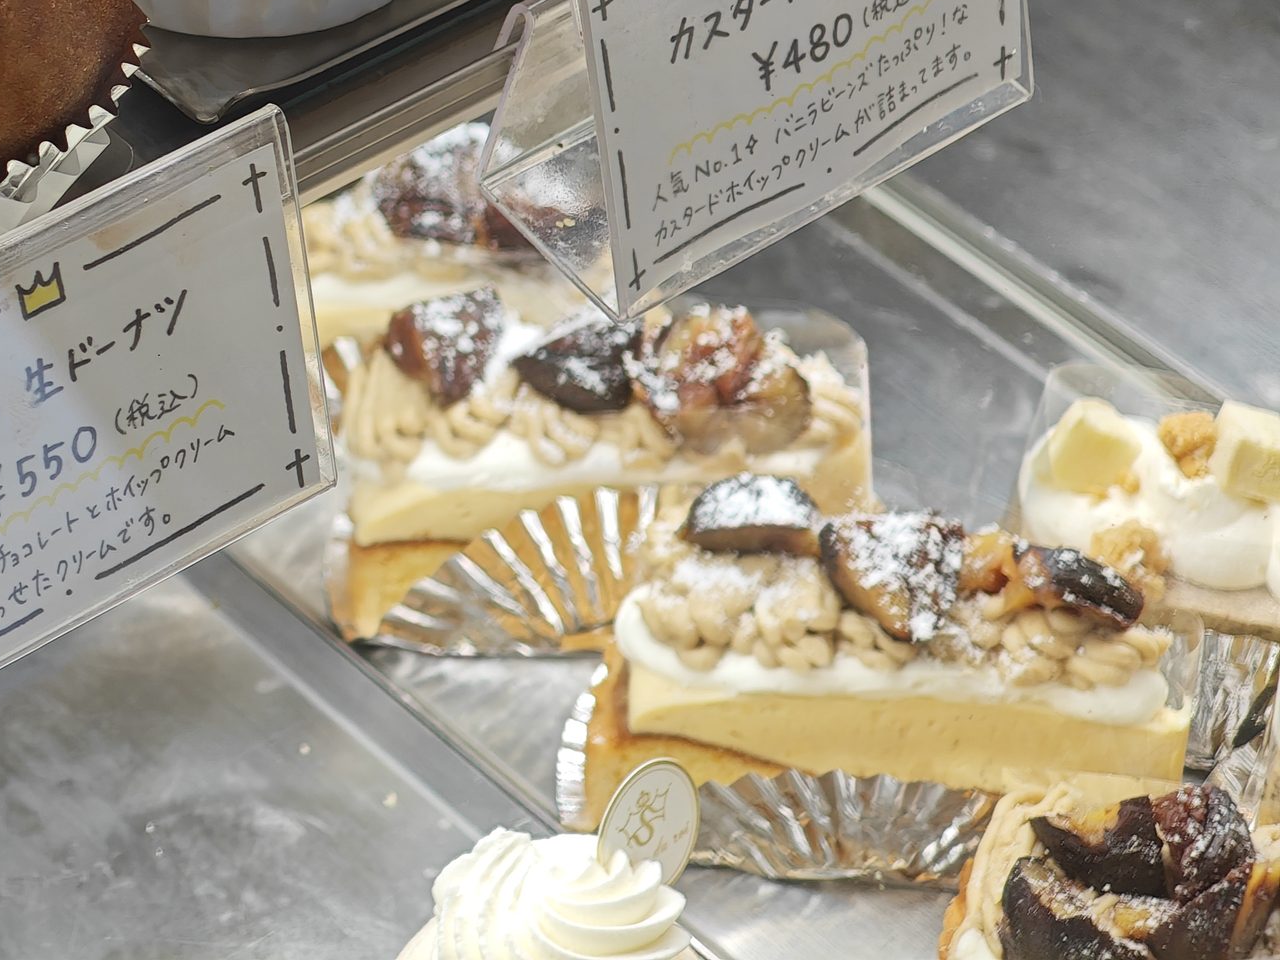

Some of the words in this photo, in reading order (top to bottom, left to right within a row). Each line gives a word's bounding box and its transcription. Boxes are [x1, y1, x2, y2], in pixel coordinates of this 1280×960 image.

[24, 288, 188, 408] 生ドーナツ
